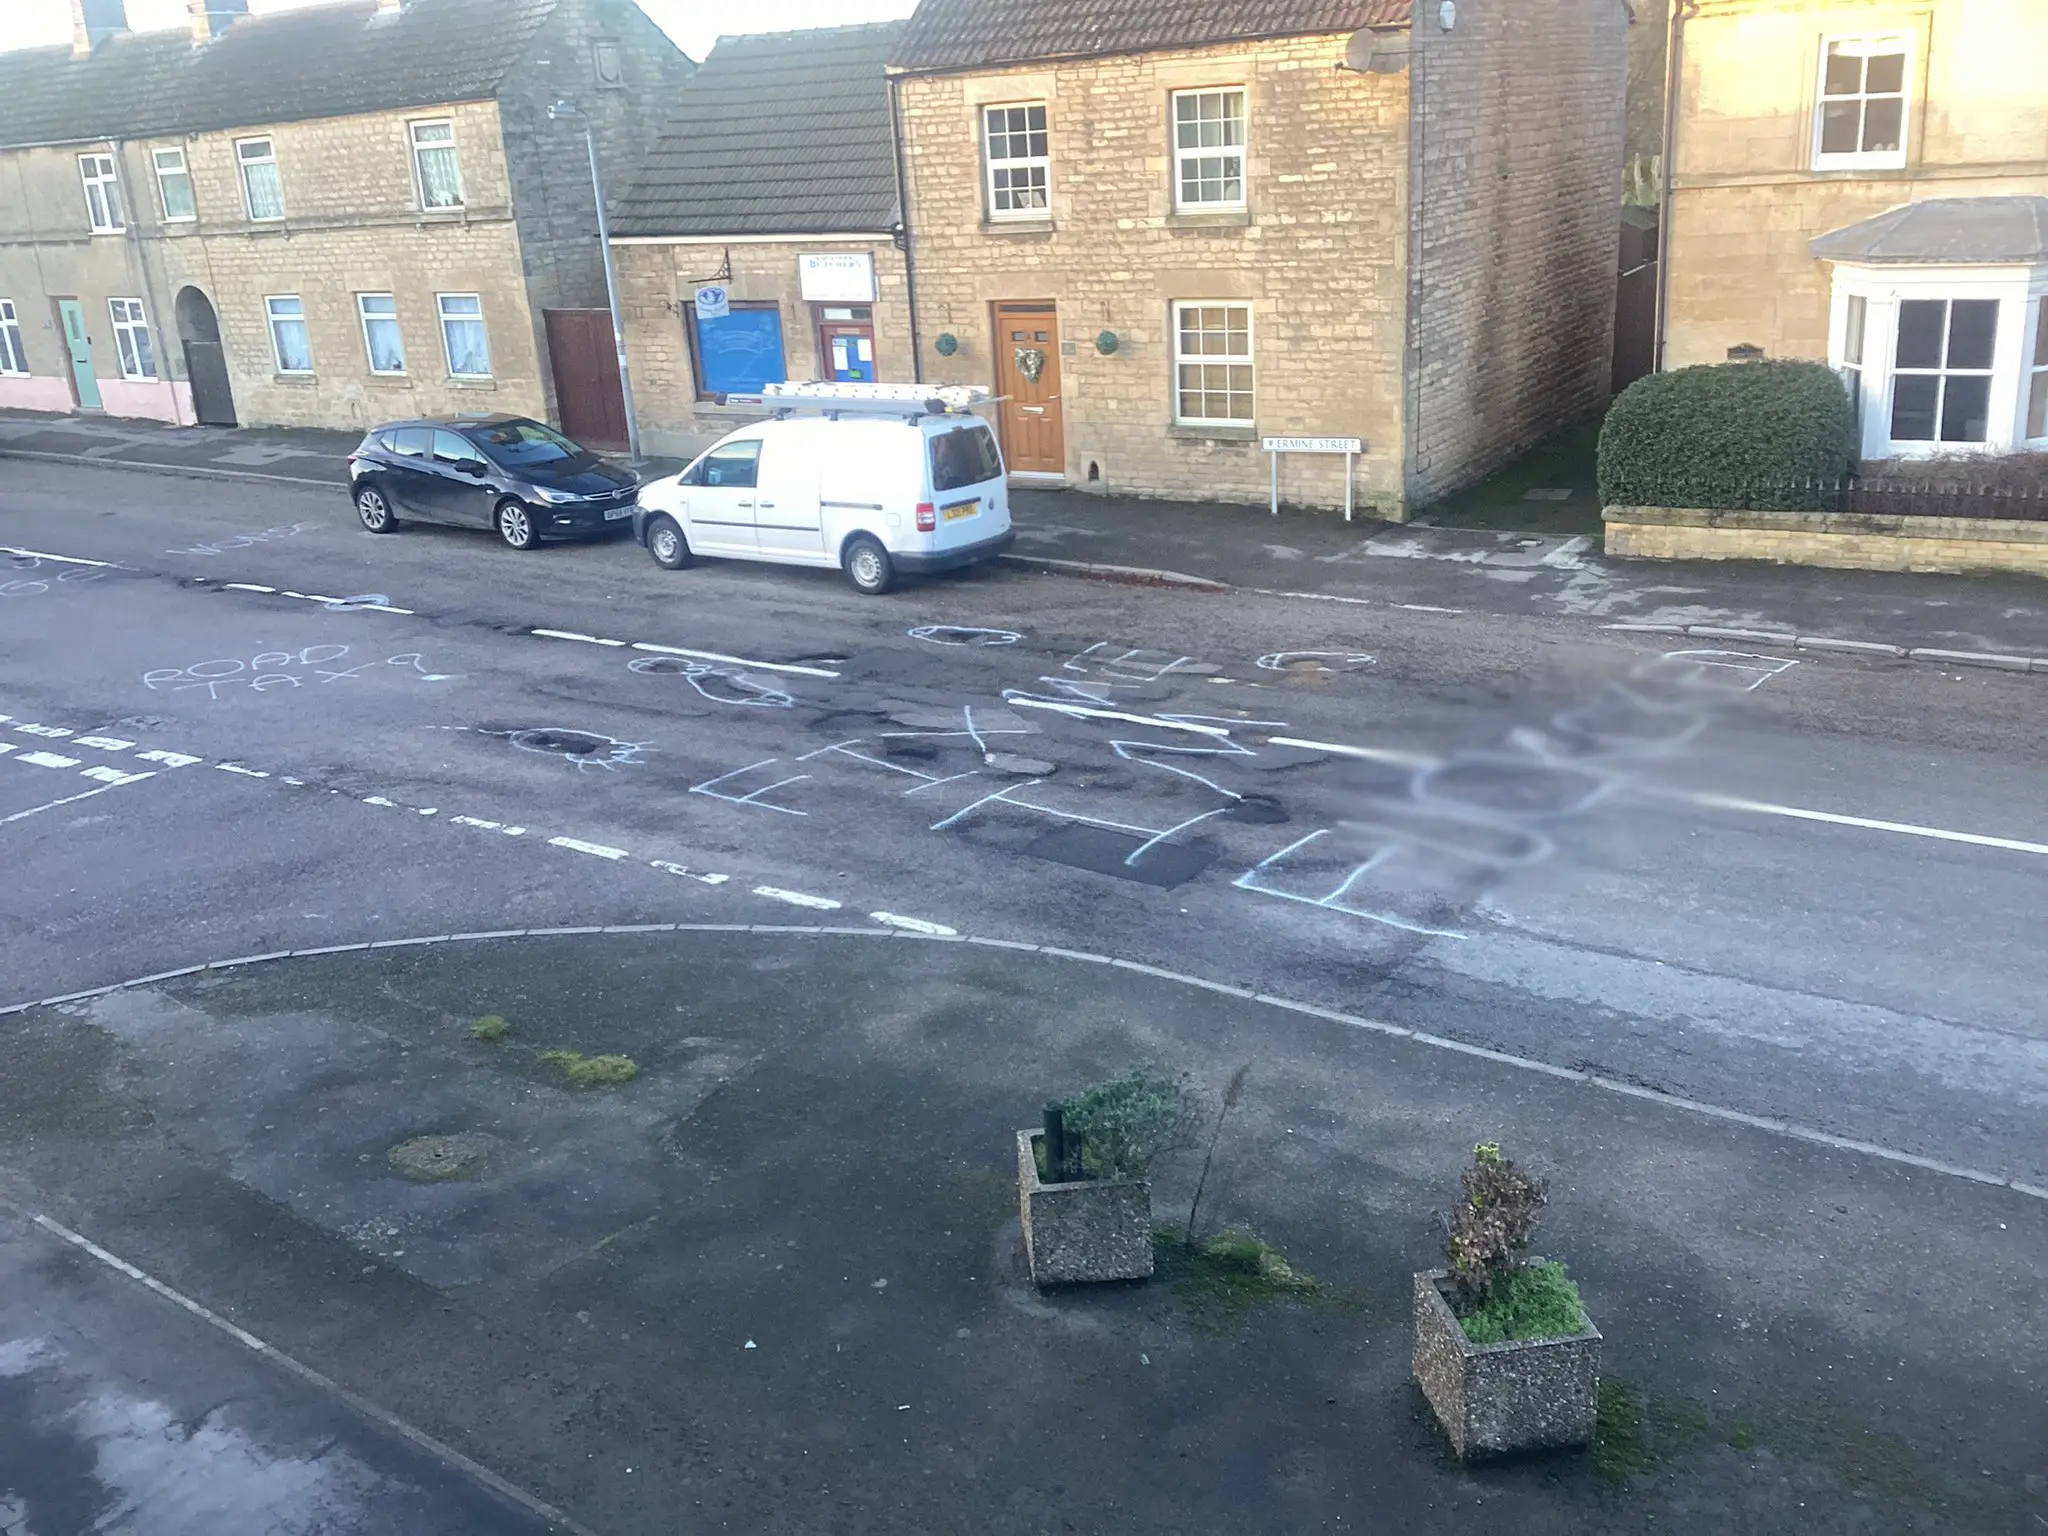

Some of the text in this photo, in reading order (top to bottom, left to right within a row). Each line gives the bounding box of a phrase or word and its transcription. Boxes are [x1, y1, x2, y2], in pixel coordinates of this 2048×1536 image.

[1276, 439, 1356, 450] ERMINE STREET
[143, 644, 350, 690] ROAD
[689, 705, 1029, 816] FIX
